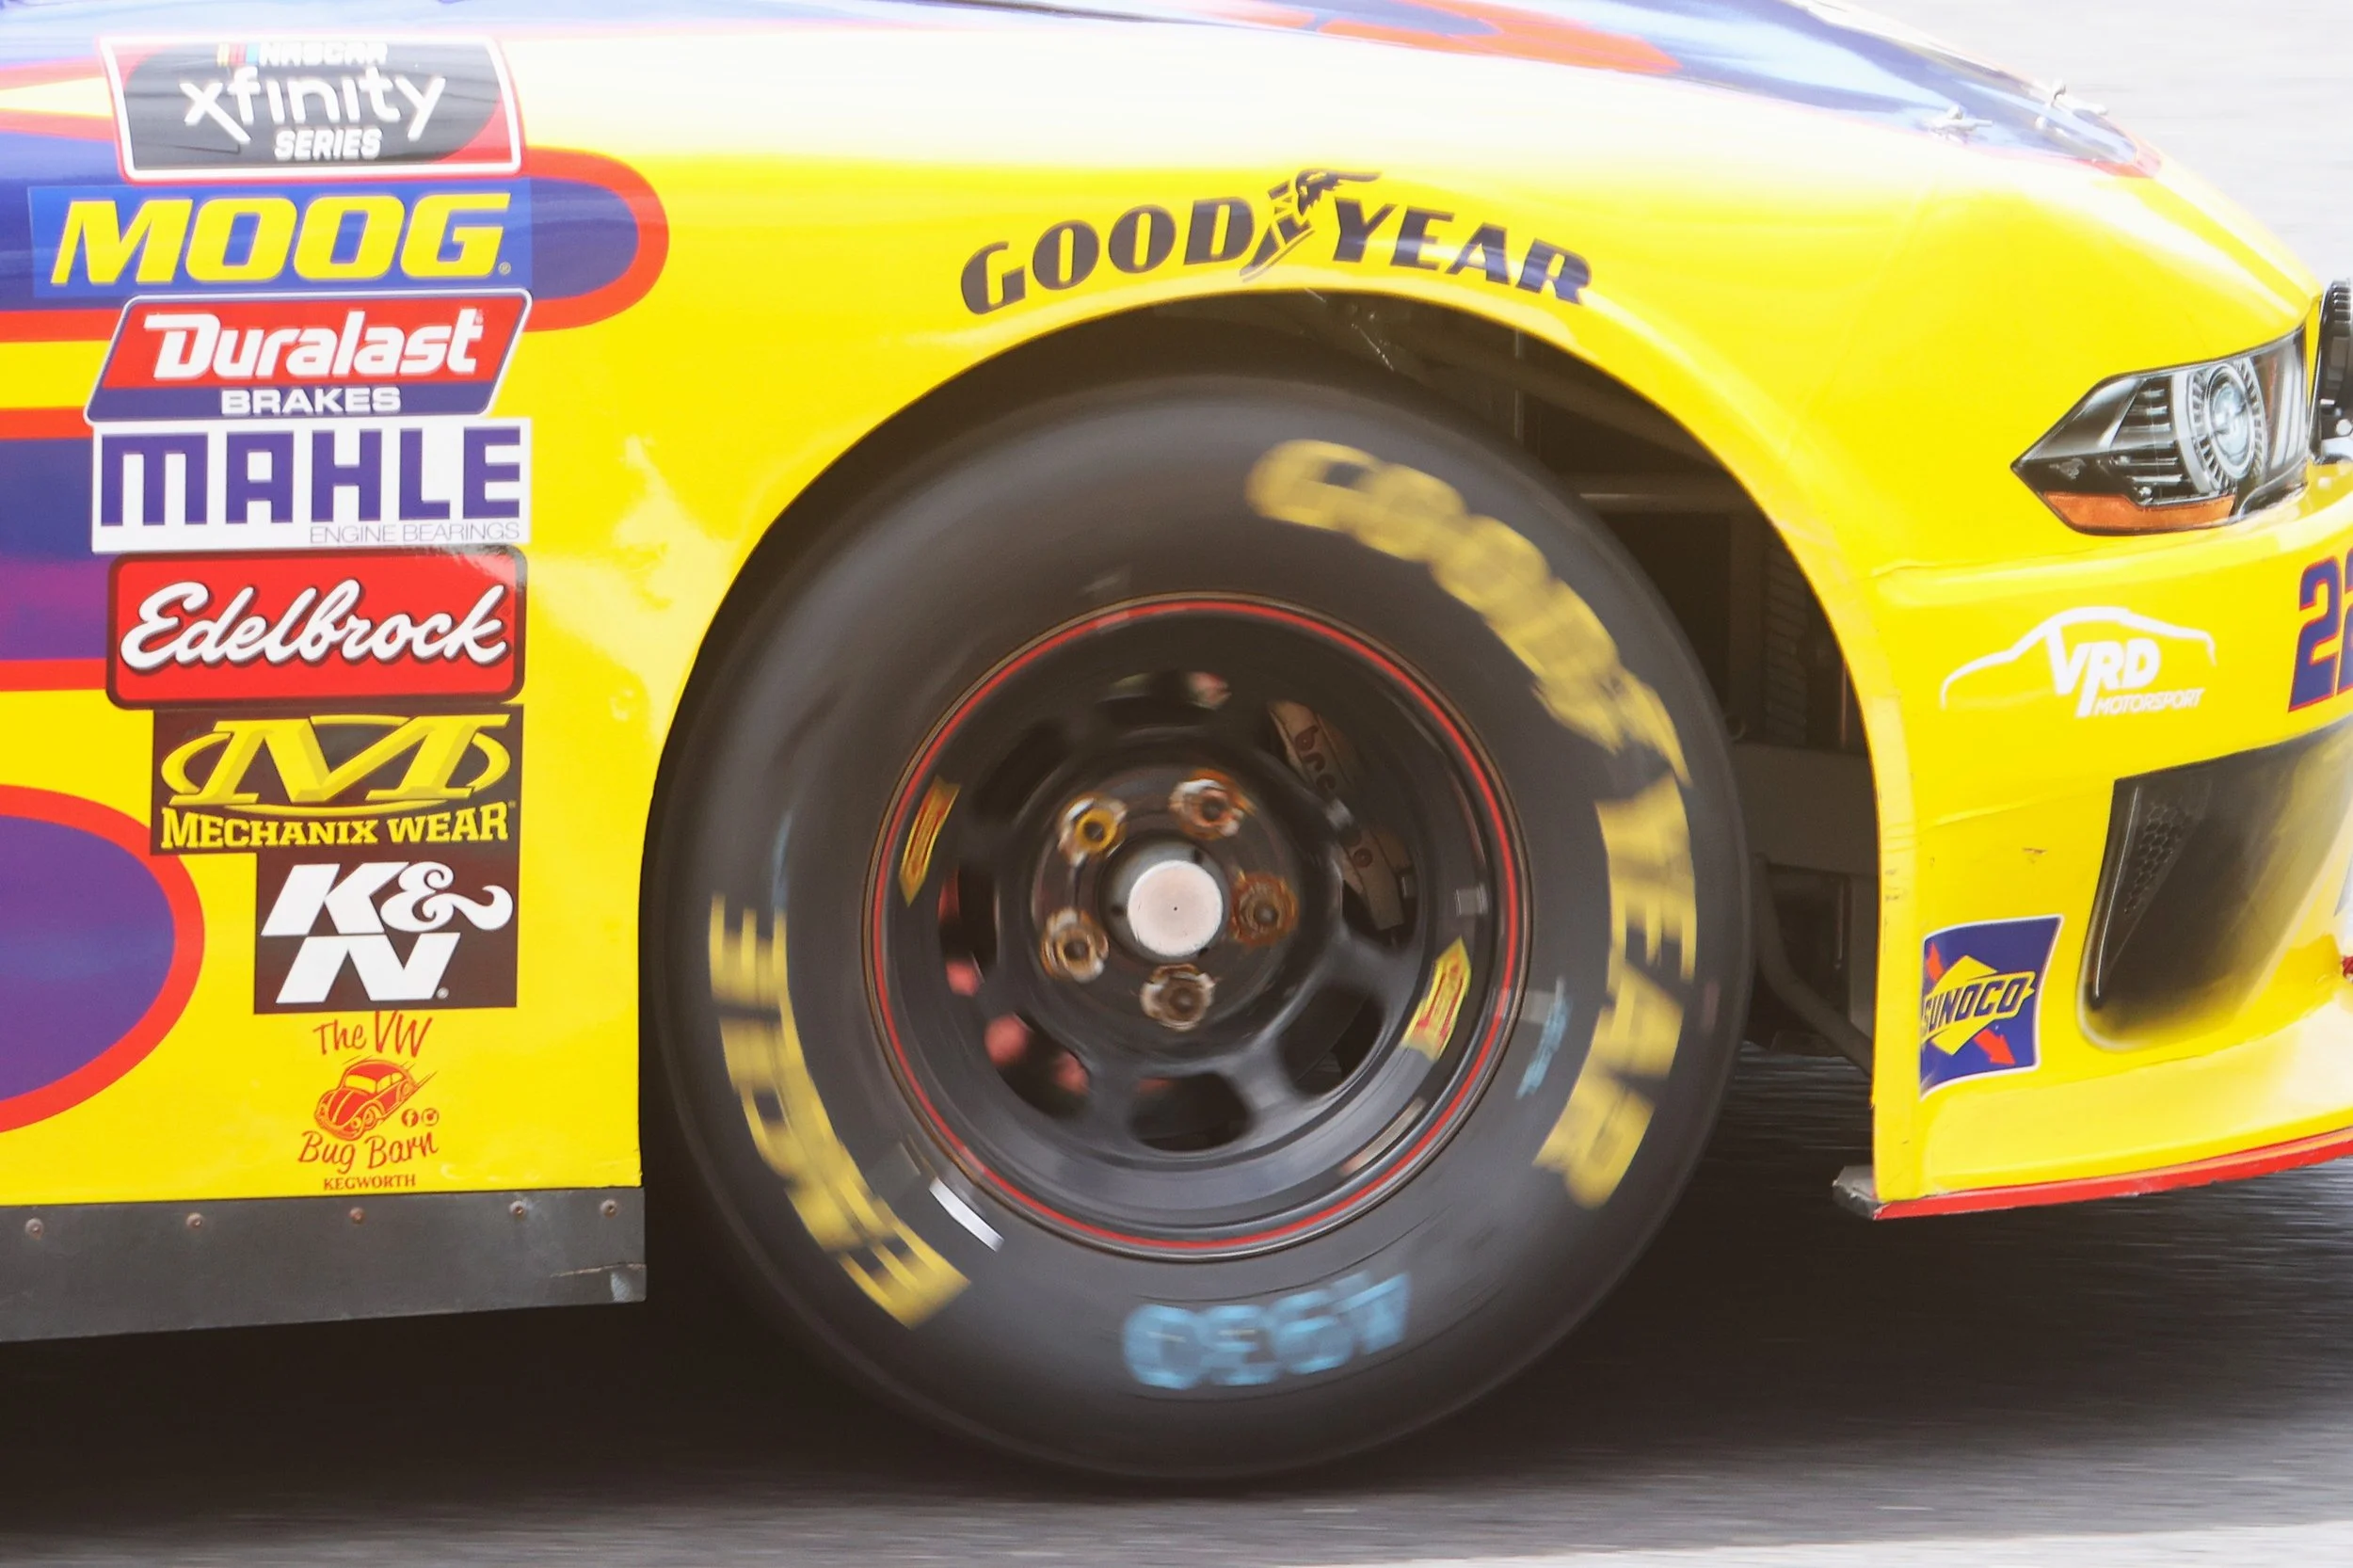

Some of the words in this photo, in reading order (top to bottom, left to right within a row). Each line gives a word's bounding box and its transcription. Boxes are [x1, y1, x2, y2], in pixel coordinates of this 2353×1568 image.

[178, 65, 447, 144] xfinity
[274, 127, 383, 161] SERIES
[51, 193, 511, 284] MOOG
[143, 309, 484, 380] Duralast
[221, 386, 401, 415] BRAKES
[101, 426, 520, 526] MAHLE
[310, 525, 396, 544] ENGINE
[402, 521, 520, 542] BEARINGS
[120, 578, 509, 673] Edelbrock
[2046, 616, 2162, 718] VRD
[2094, 687, 2205, 716] MOTORSPORT
[1294, 725, 1373, 868] breo
[161, 807, 378, 849] MECHANIX
[387, 801, 508, 843] WEAR
[312, 1018, 367, 1055] The
[375, 1010, 433, 1058] VW
[297, 1130, 356, 1175] Bug
[364, 1131, 439, 1169] Barn
[323, 1174, 416, 1192] KEGWORTH
